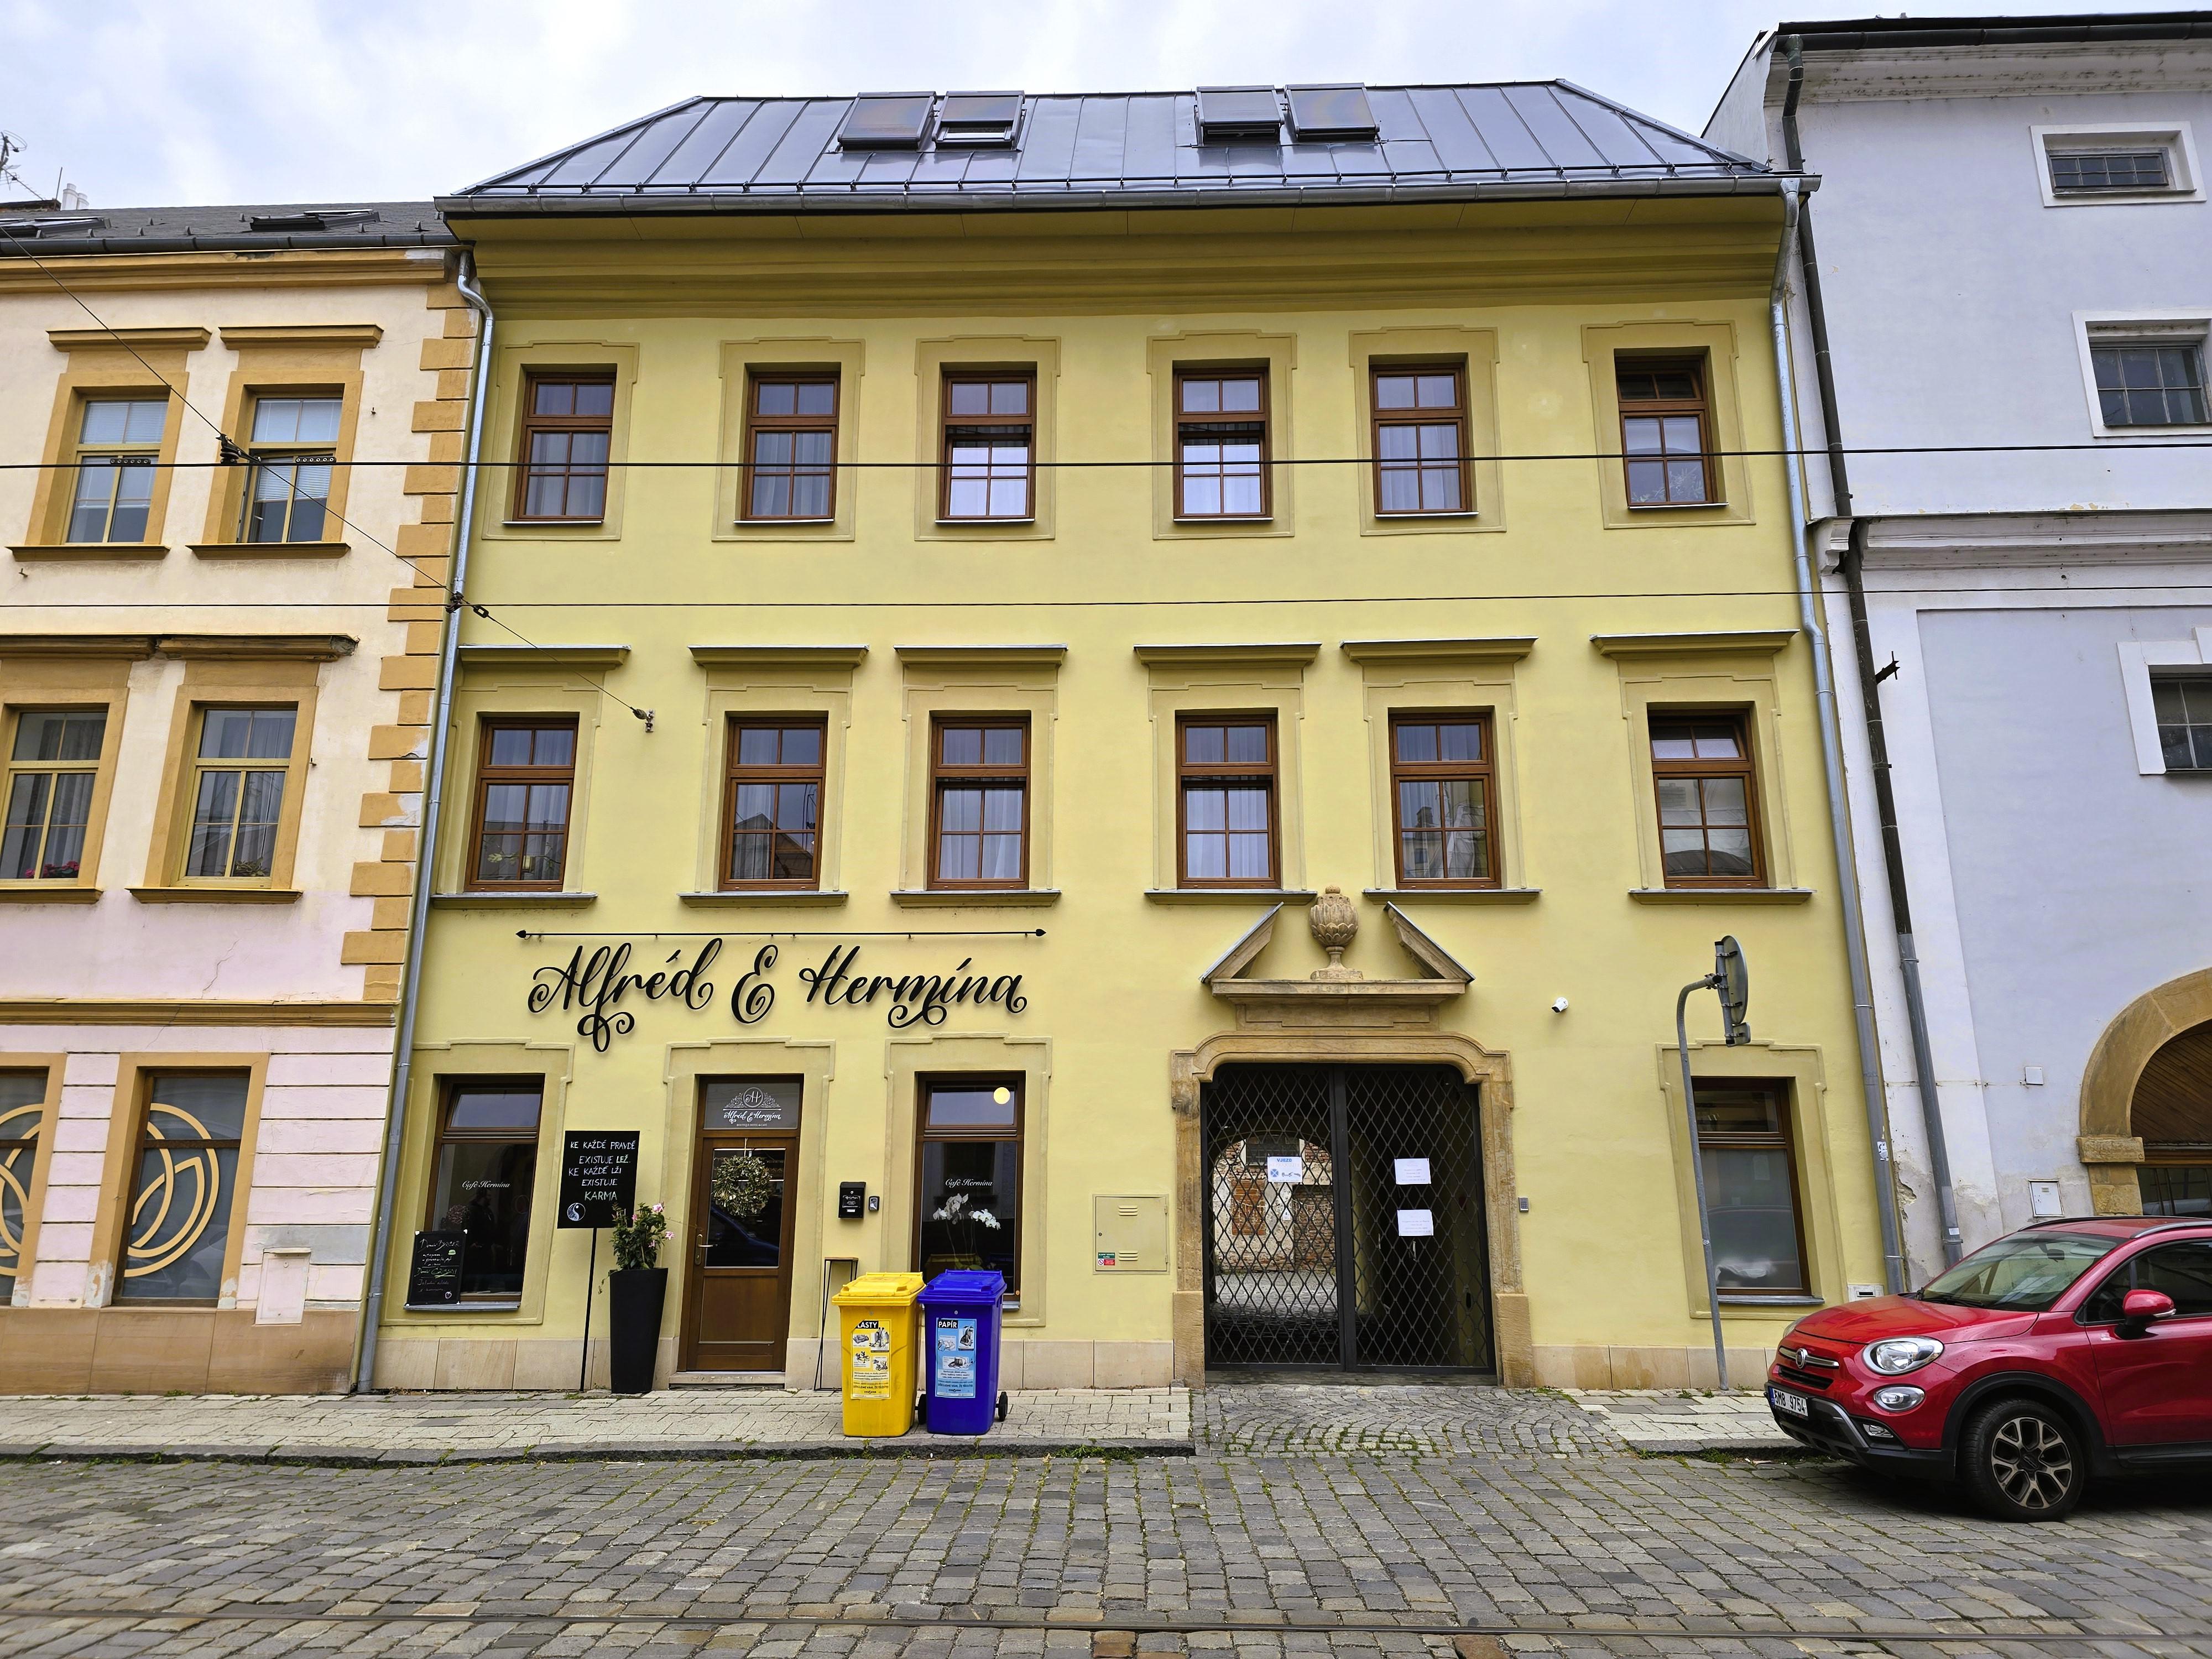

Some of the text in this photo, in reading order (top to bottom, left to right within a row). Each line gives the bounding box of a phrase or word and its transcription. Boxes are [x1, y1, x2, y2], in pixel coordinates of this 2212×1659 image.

[528, 938, 723, 1052] Alfréd
[799, 945, 1027, 1029] Hermína
[579, 1155, 614, 1165] EXISTUJE
[568, 1167, 580, 1176] KE
[611, 1166, 622, 1174] LŽI
[581, 1178, 618, 1187] EXISTUJE
[585, 1191, 618, 1201] KARMA
[938, 1320, 957, 1328] PAPÍR
[1774, 1390, 1806, 1414] 5M8 9754
